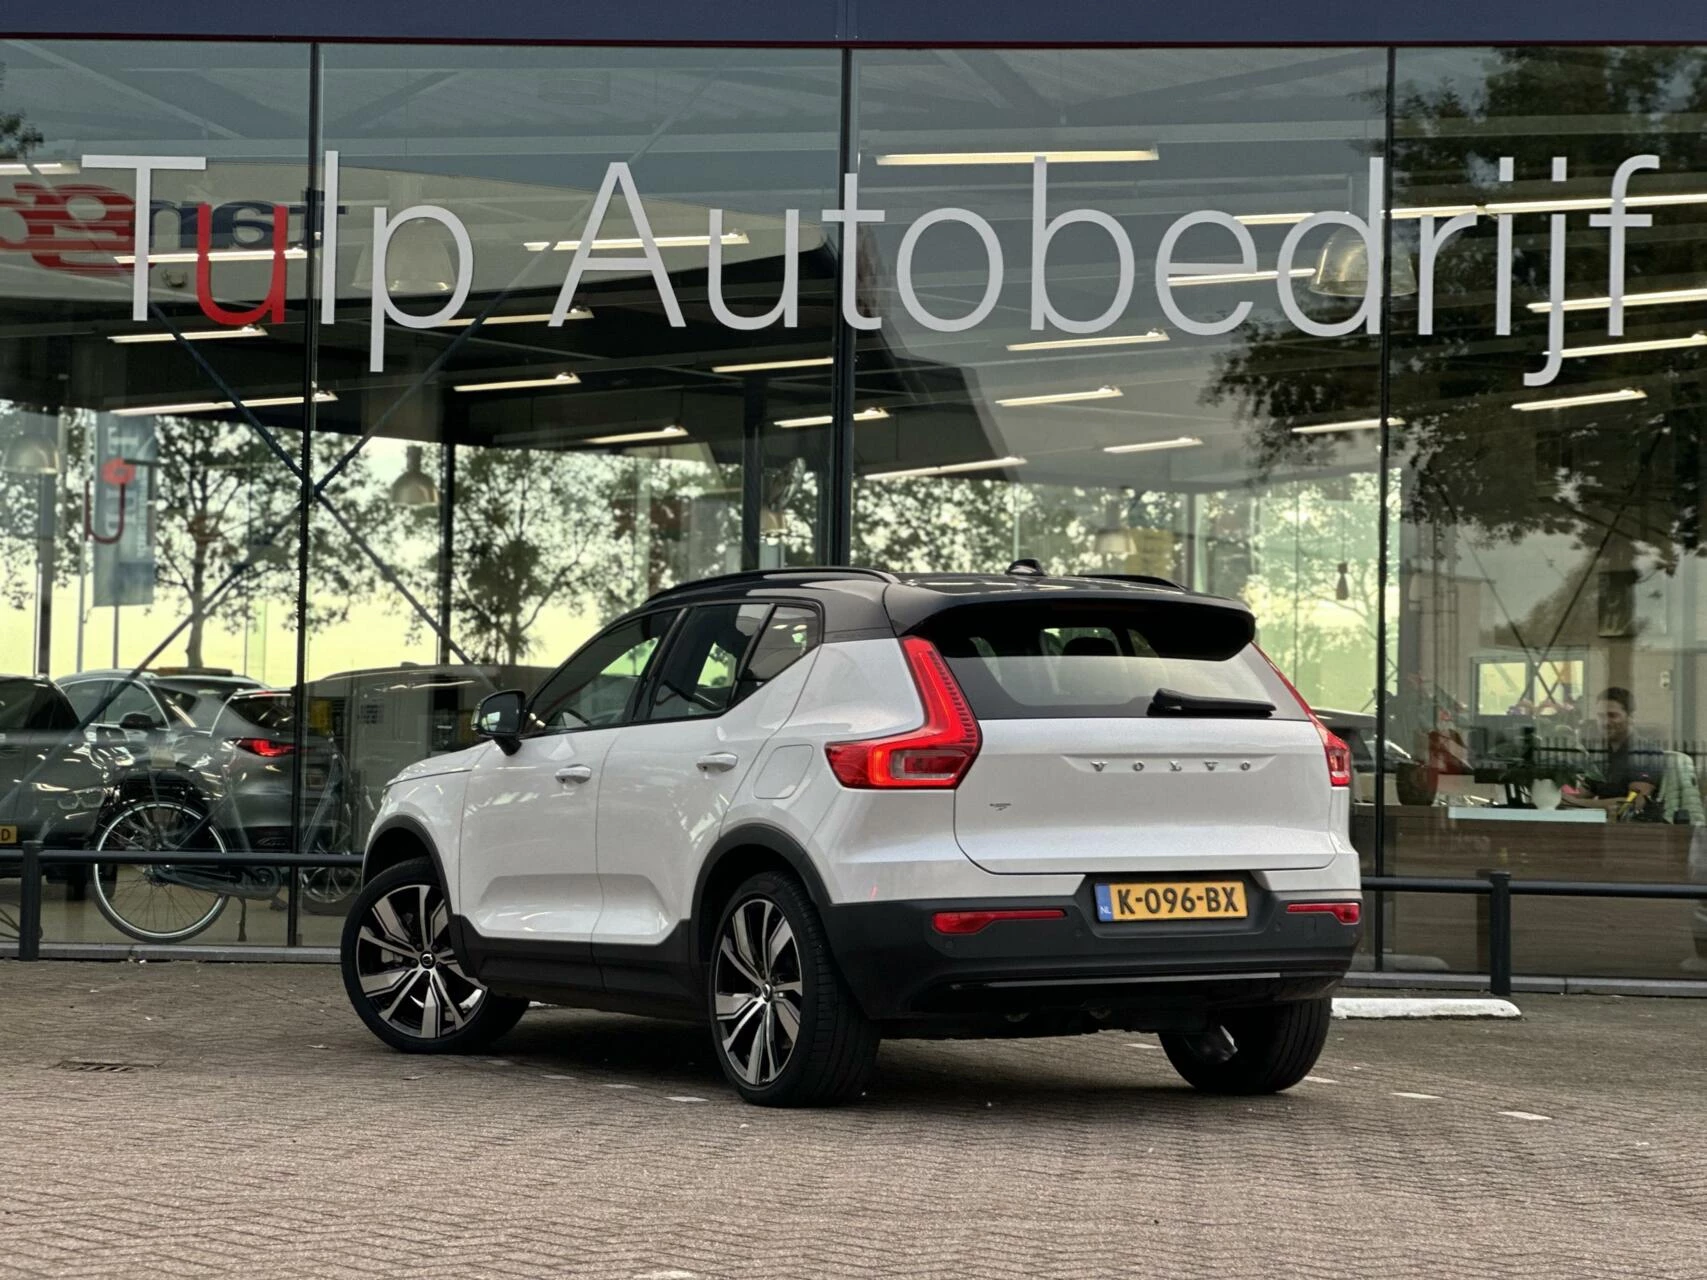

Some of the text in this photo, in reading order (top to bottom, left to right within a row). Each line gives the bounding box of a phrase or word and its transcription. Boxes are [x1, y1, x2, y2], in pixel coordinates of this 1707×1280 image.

[82, 150, 1660, 386] Tulp Autobedrijf
[1091, 761, 1250, 771] VOLVO
[1117, 887, 1238, 915] K-096-BX
